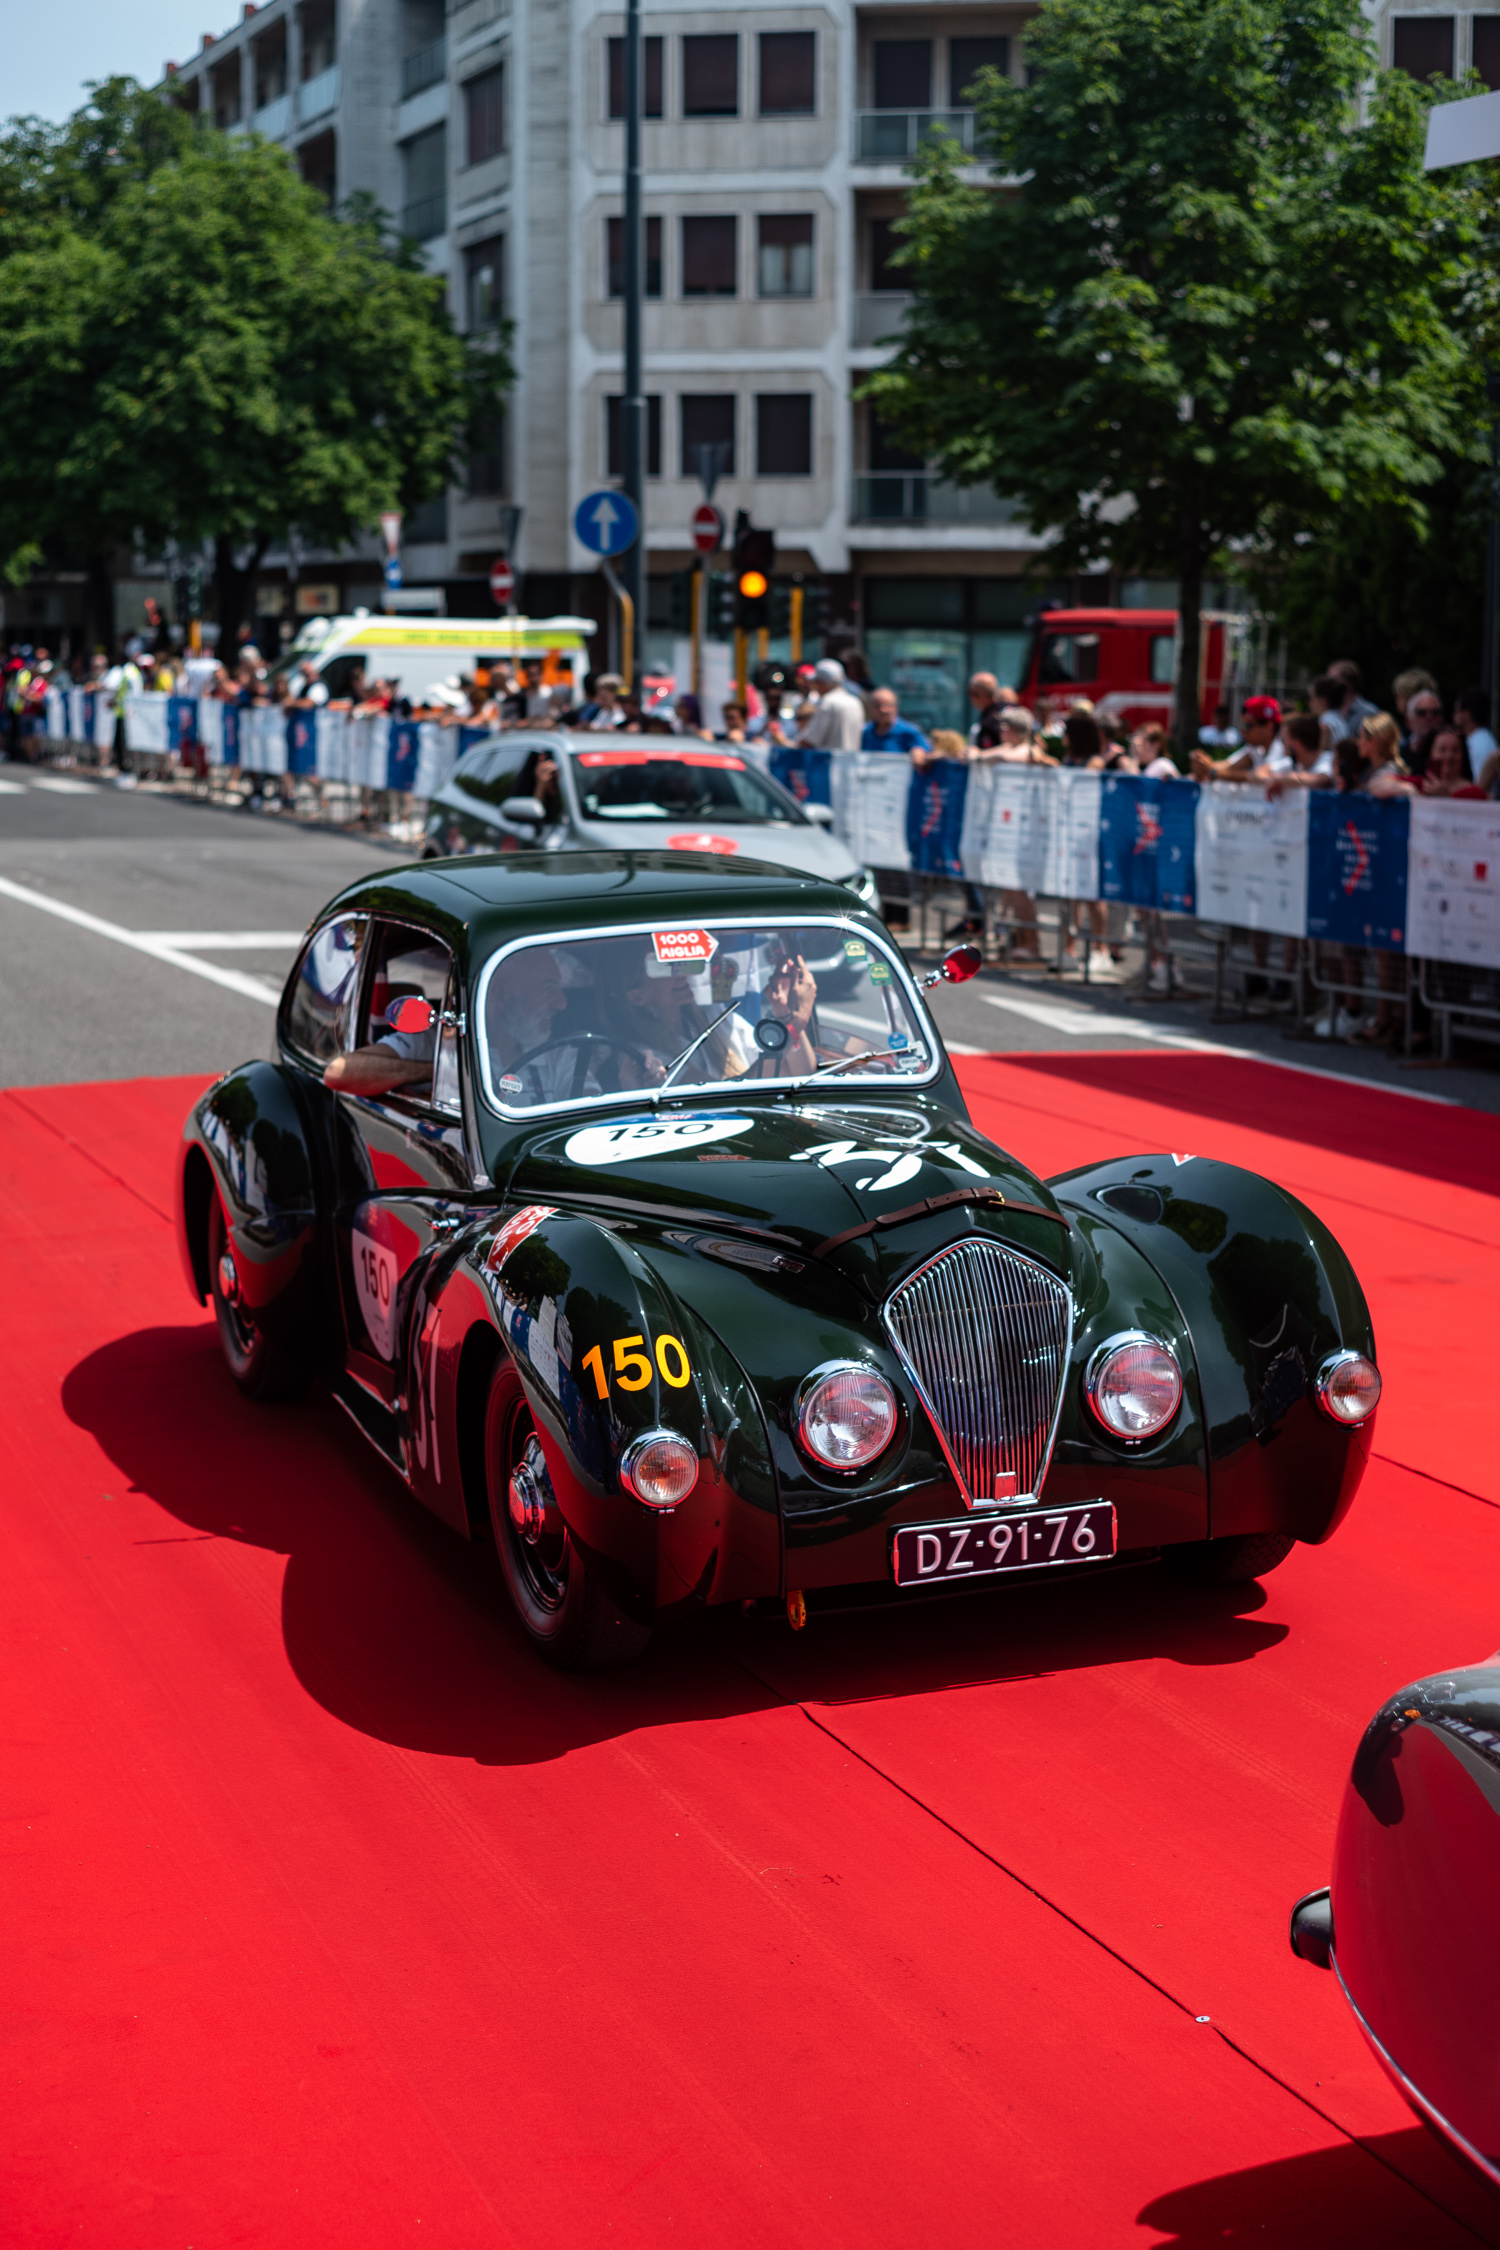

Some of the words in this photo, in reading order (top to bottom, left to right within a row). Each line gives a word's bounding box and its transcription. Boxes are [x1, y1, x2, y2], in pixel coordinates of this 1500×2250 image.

[660, 932, 699, 945] 1000
[661, 945, 705, 958] MIGLIA
[608, 1123, 714, 1142] 150
[361, 1247, 390, 1307] 150
[581, 1334, 691, 1401] 150
[917, 1513, 1097, 1575] DZ-91-76
